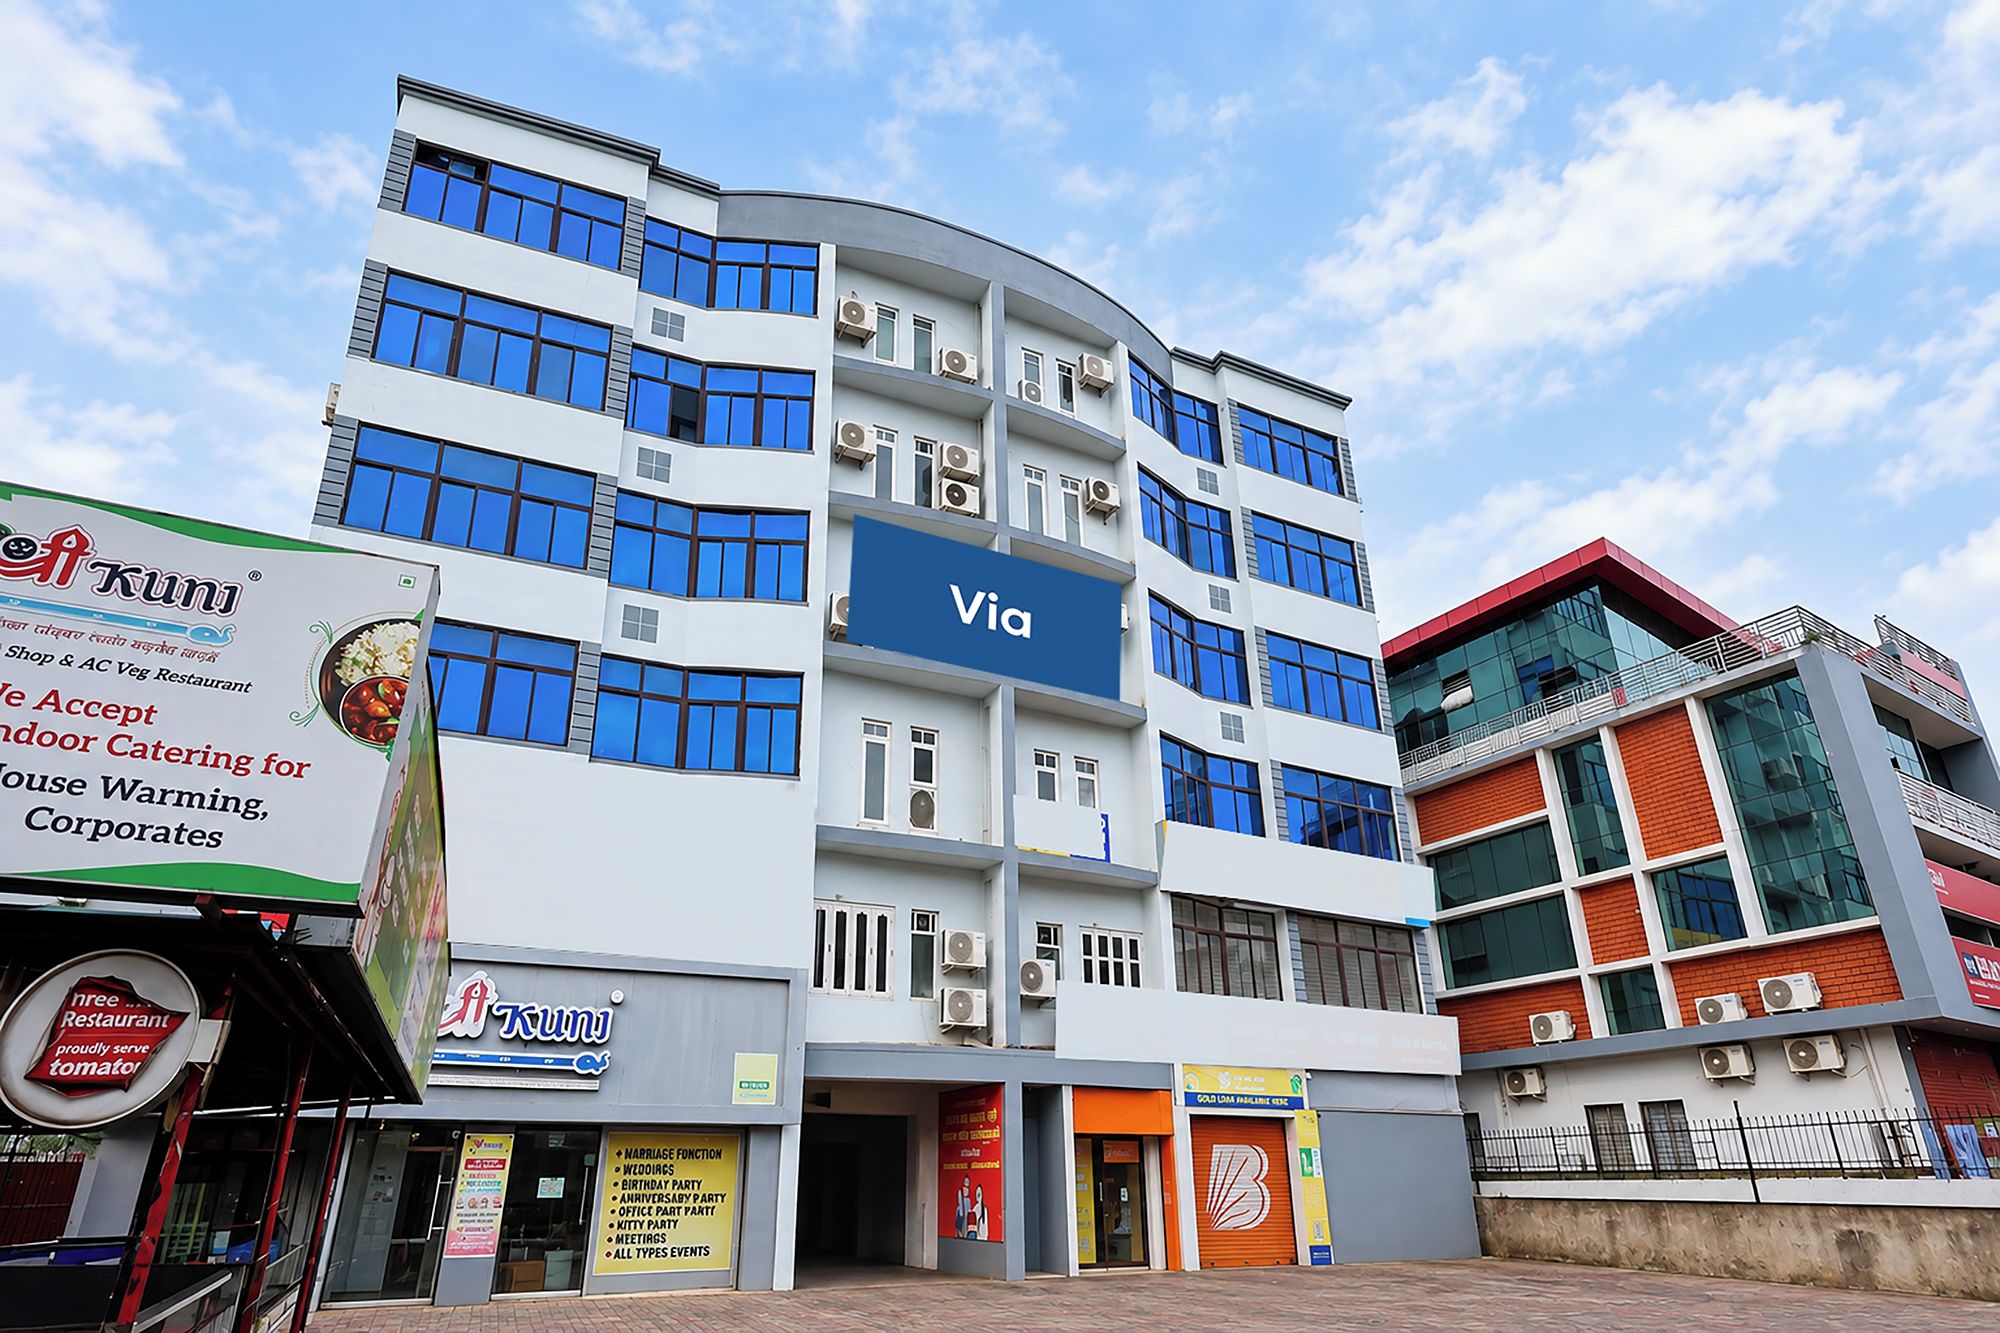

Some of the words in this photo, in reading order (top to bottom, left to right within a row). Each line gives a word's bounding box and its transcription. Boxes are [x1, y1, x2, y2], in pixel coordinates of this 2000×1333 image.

[950, 584, 1031, 638] Via
[4, 645, 55, 667] Shop
[59, 654, 75, 667] &
[78, 657, 112, 673] AC
[116, 661, 151, 681] Veg
[153, 667, 253, 693] Restaurant
[33, 689, 157, 726] Accept
[106, 734, 254, 776] Catering
[260, 753, 311, 778] for
[0, 763, 87, 795] ouse
[100, 776, 269, 821] Warming,
[25, 807, 223, 848] Corporates
[61, 1011, 170, 1028] Restaurant
[55, 1042, 110, 1056] proudly
[113, 1045, 149, 1053] serve
[621, 1179, 669, 1190] BIRTHDAY
[671, 1179, 702, 1190] PARTY
[693, 1193, 726, 1204] PARTY
[655, 1206, 681, 1217] PART
[616, 1219, 645, 1230] KITTY
[647, 1219, 679, 1230] PARTY
[613, 1248, 633, 1259] ALL
[635, 1247, 668, 1259] TYPES
[670, 1246, 711, 1258] EVENTS
